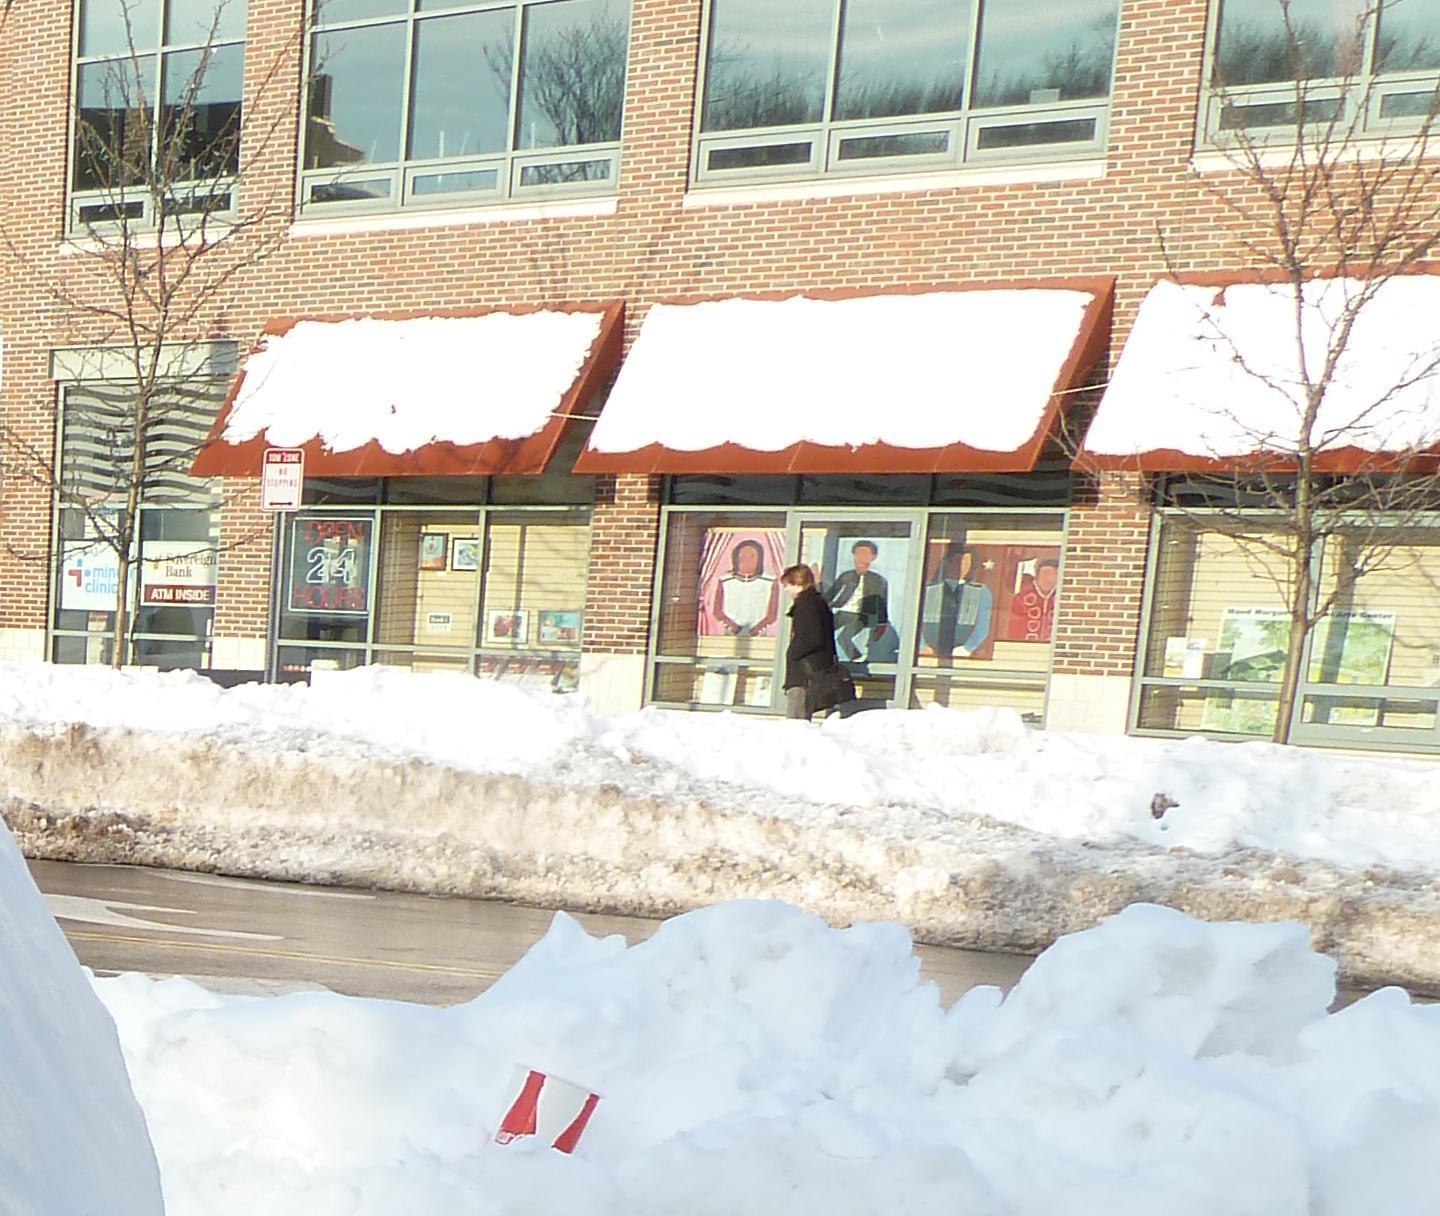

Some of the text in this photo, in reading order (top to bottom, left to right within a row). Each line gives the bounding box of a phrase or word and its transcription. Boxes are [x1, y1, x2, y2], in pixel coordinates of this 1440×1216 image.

[305, 521, 364, 545] OPEN
[165, 566, 192, 577] Bank
[306, 546, 355, 584] 24
[151, 588, 210, 601] ATM INSIDE
